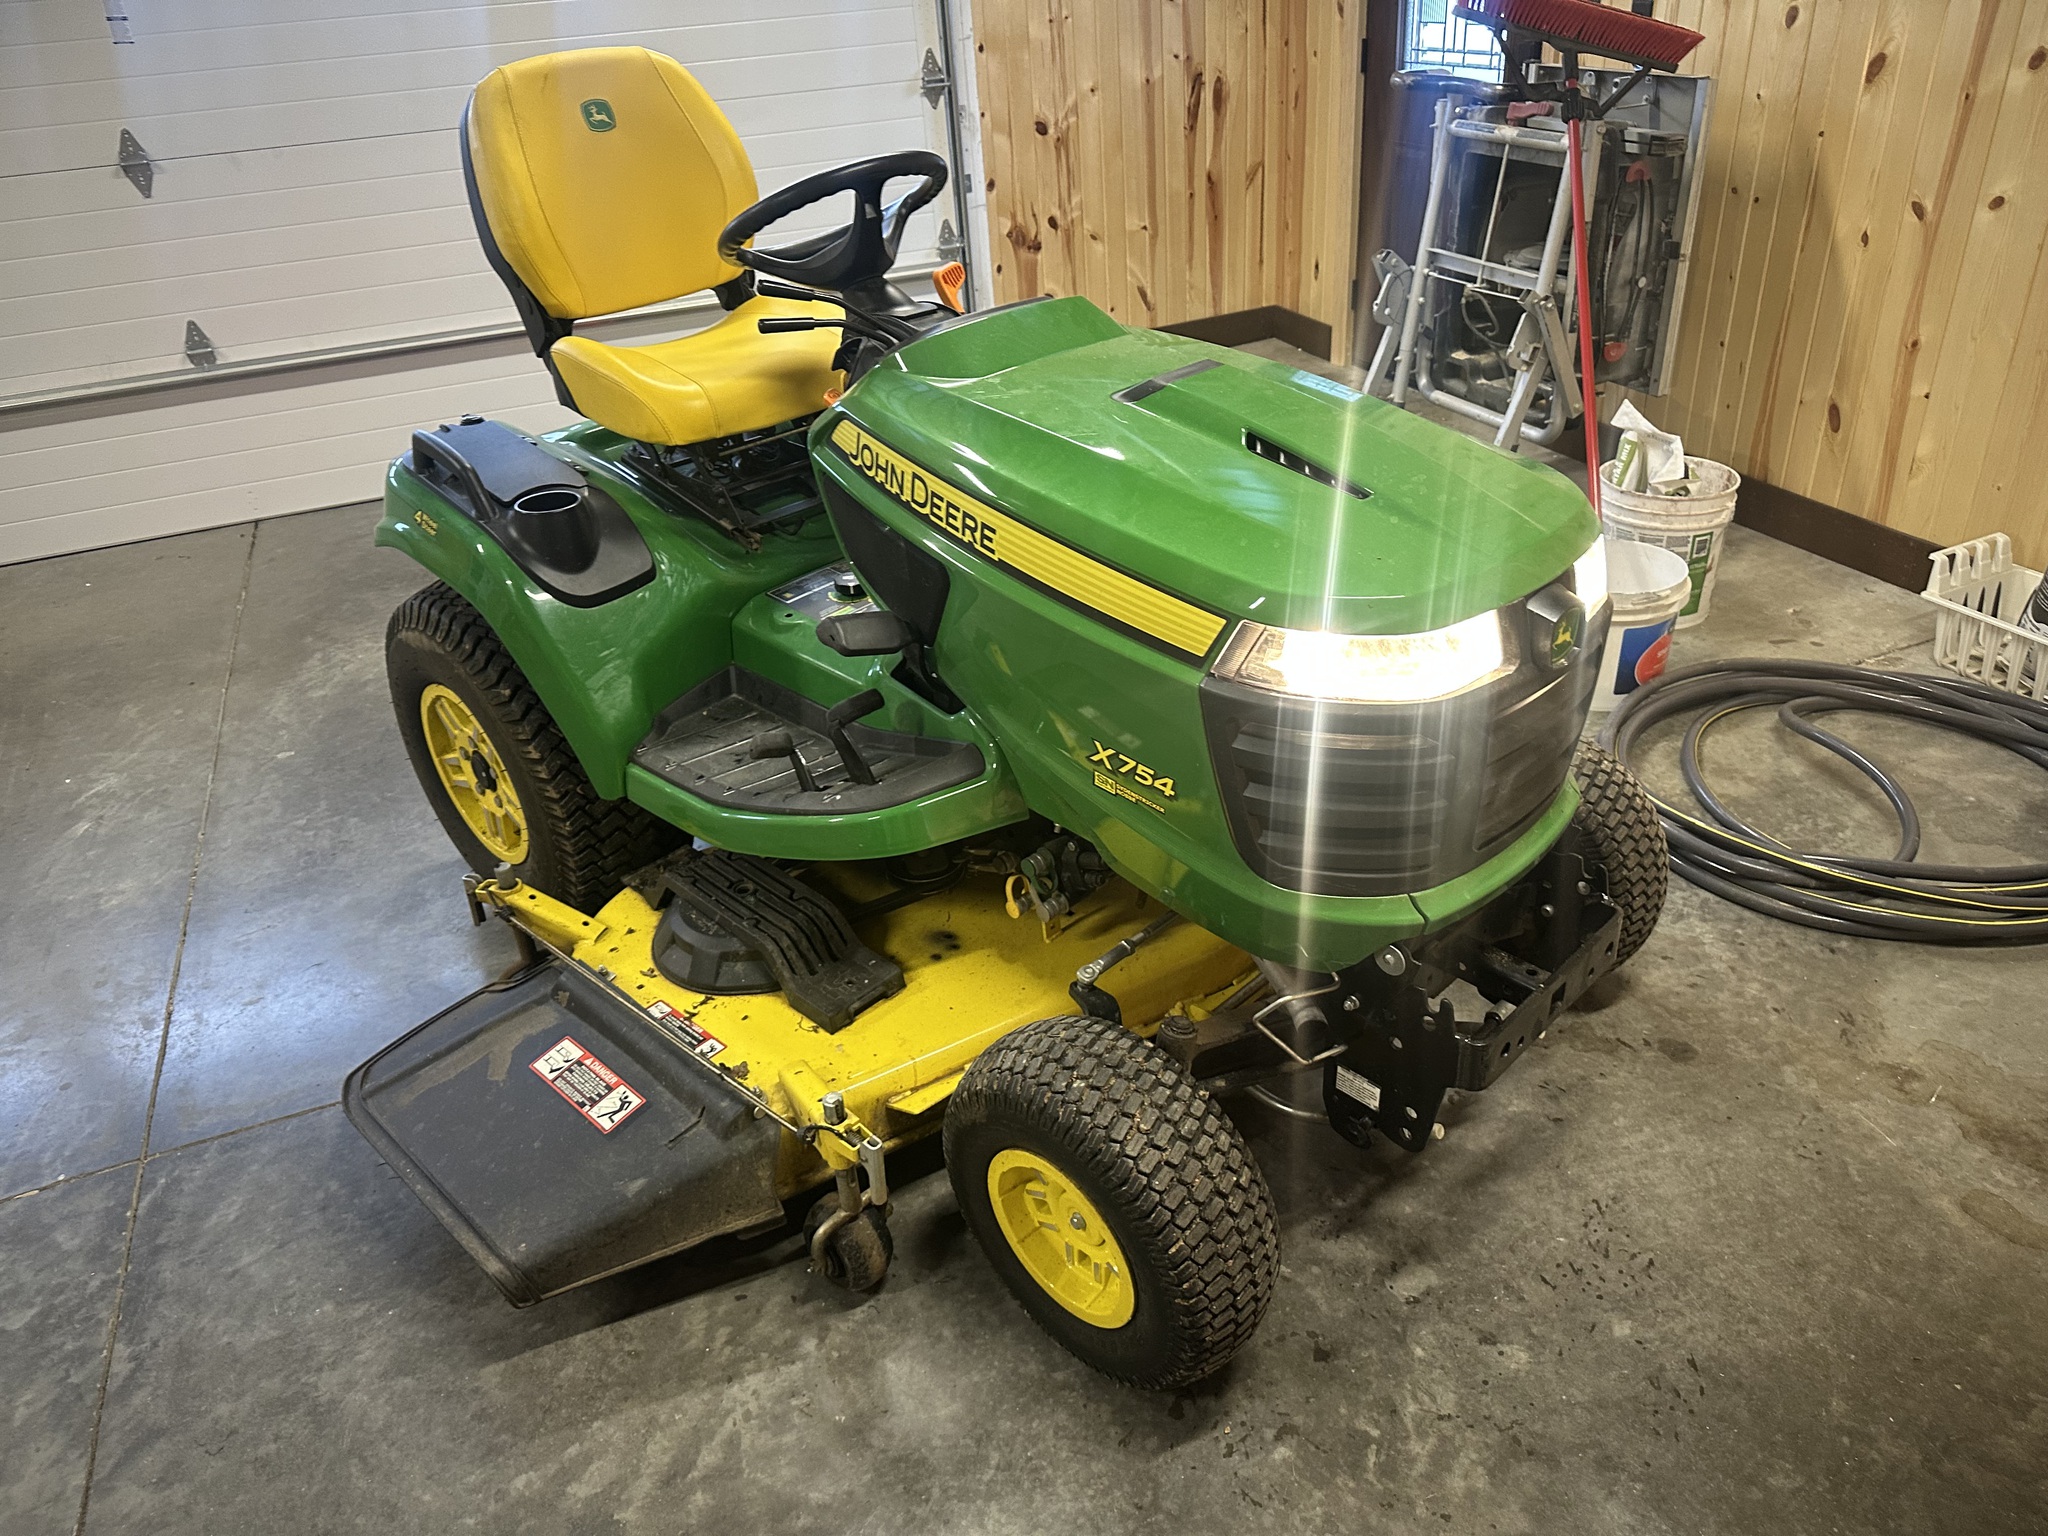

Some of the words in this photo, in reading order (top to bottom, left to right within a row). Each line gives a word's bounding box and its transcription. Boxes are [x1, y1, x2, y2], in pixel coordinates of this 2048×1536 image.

[1620, 443, 1632, 461] MIX
[849, 432, 905, 496] JOHN
[911, 471, 997, 555] DEERE
[1088, 739, 1176, 797] X754
[589, 1061, 618, 1085] DANGER
